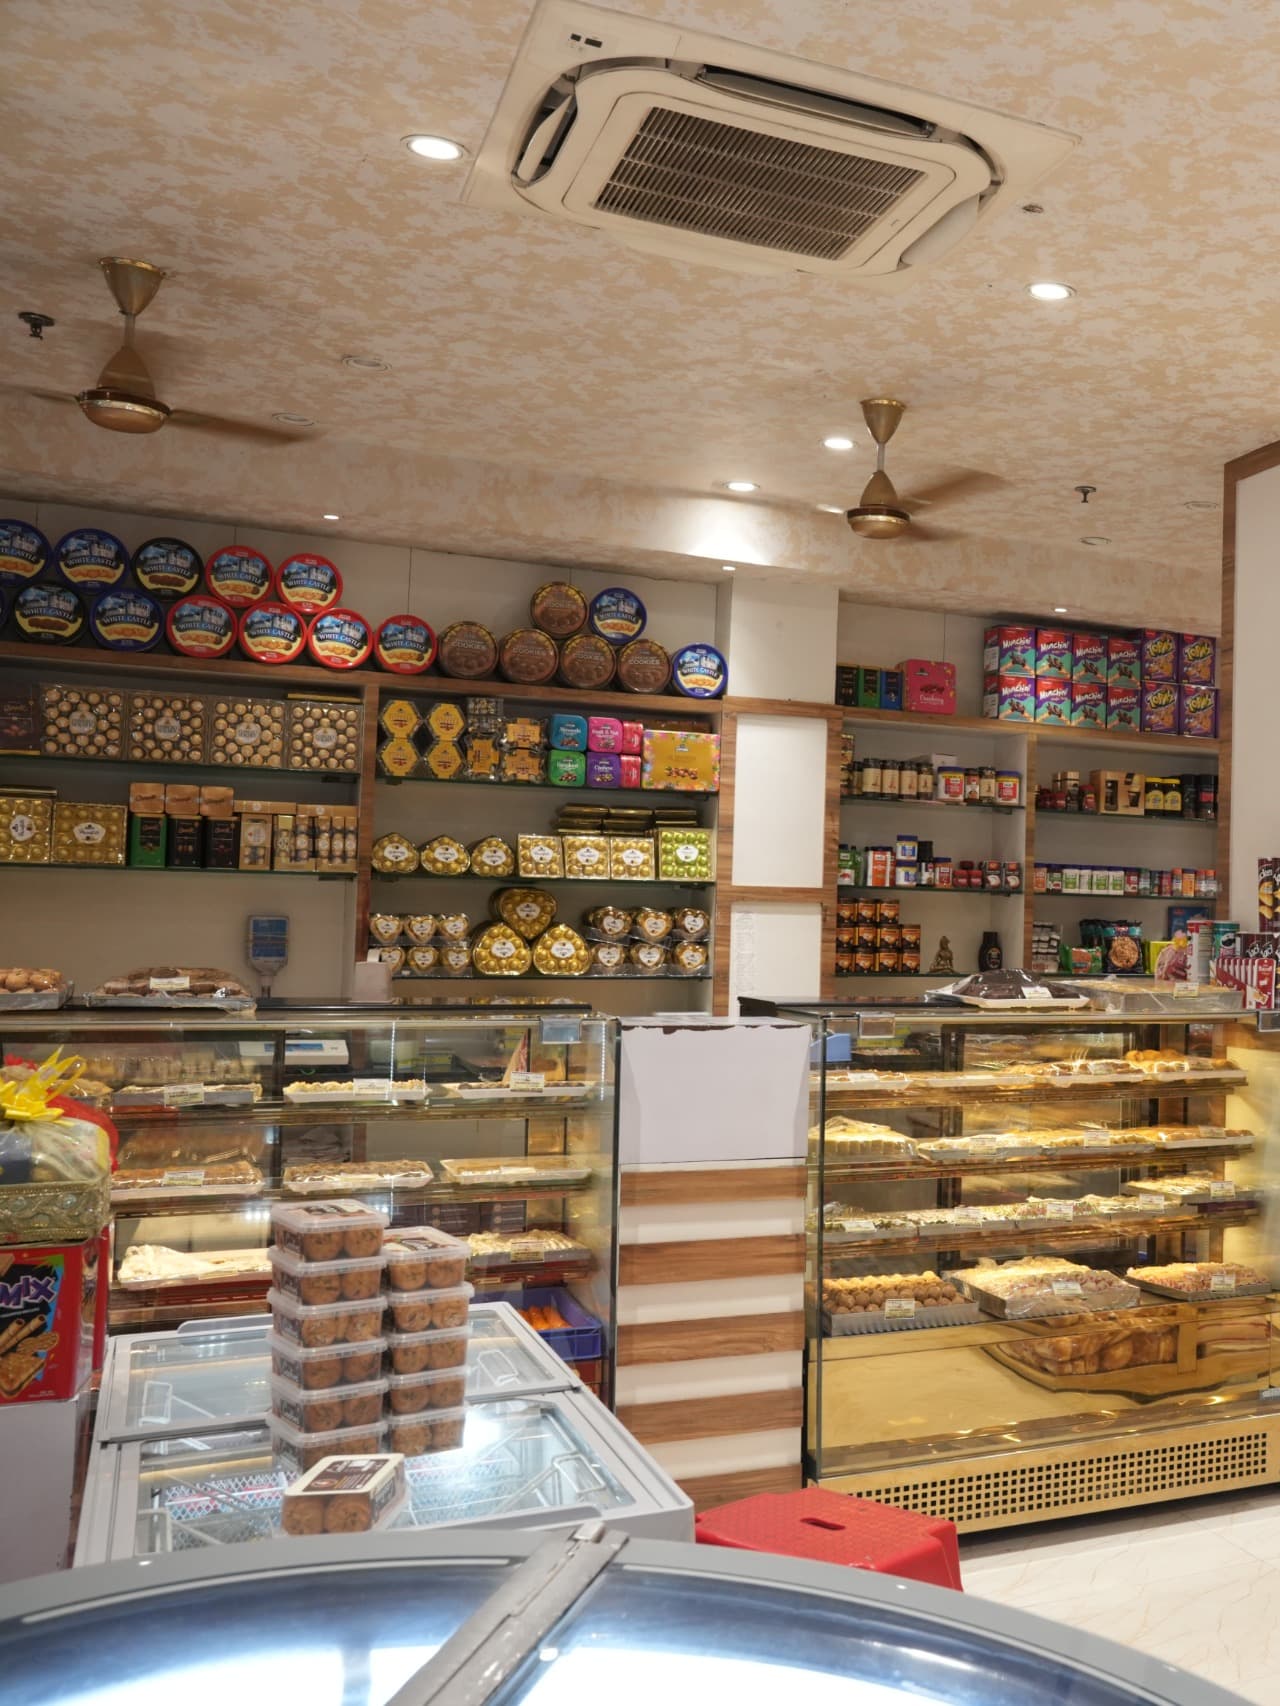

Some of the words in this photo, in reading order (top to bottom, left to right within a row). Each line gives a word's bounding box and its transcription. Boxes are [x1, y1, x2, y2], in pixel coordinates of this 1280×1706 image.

[308, 578, 330, 591] CASTLE
[201, 622, 225, 635] CASTLE
[251, 628, 271, 636] WHITE
[271, 627, 295, 640] CASTLE
[340, 633, 361, 648] CASTLE
